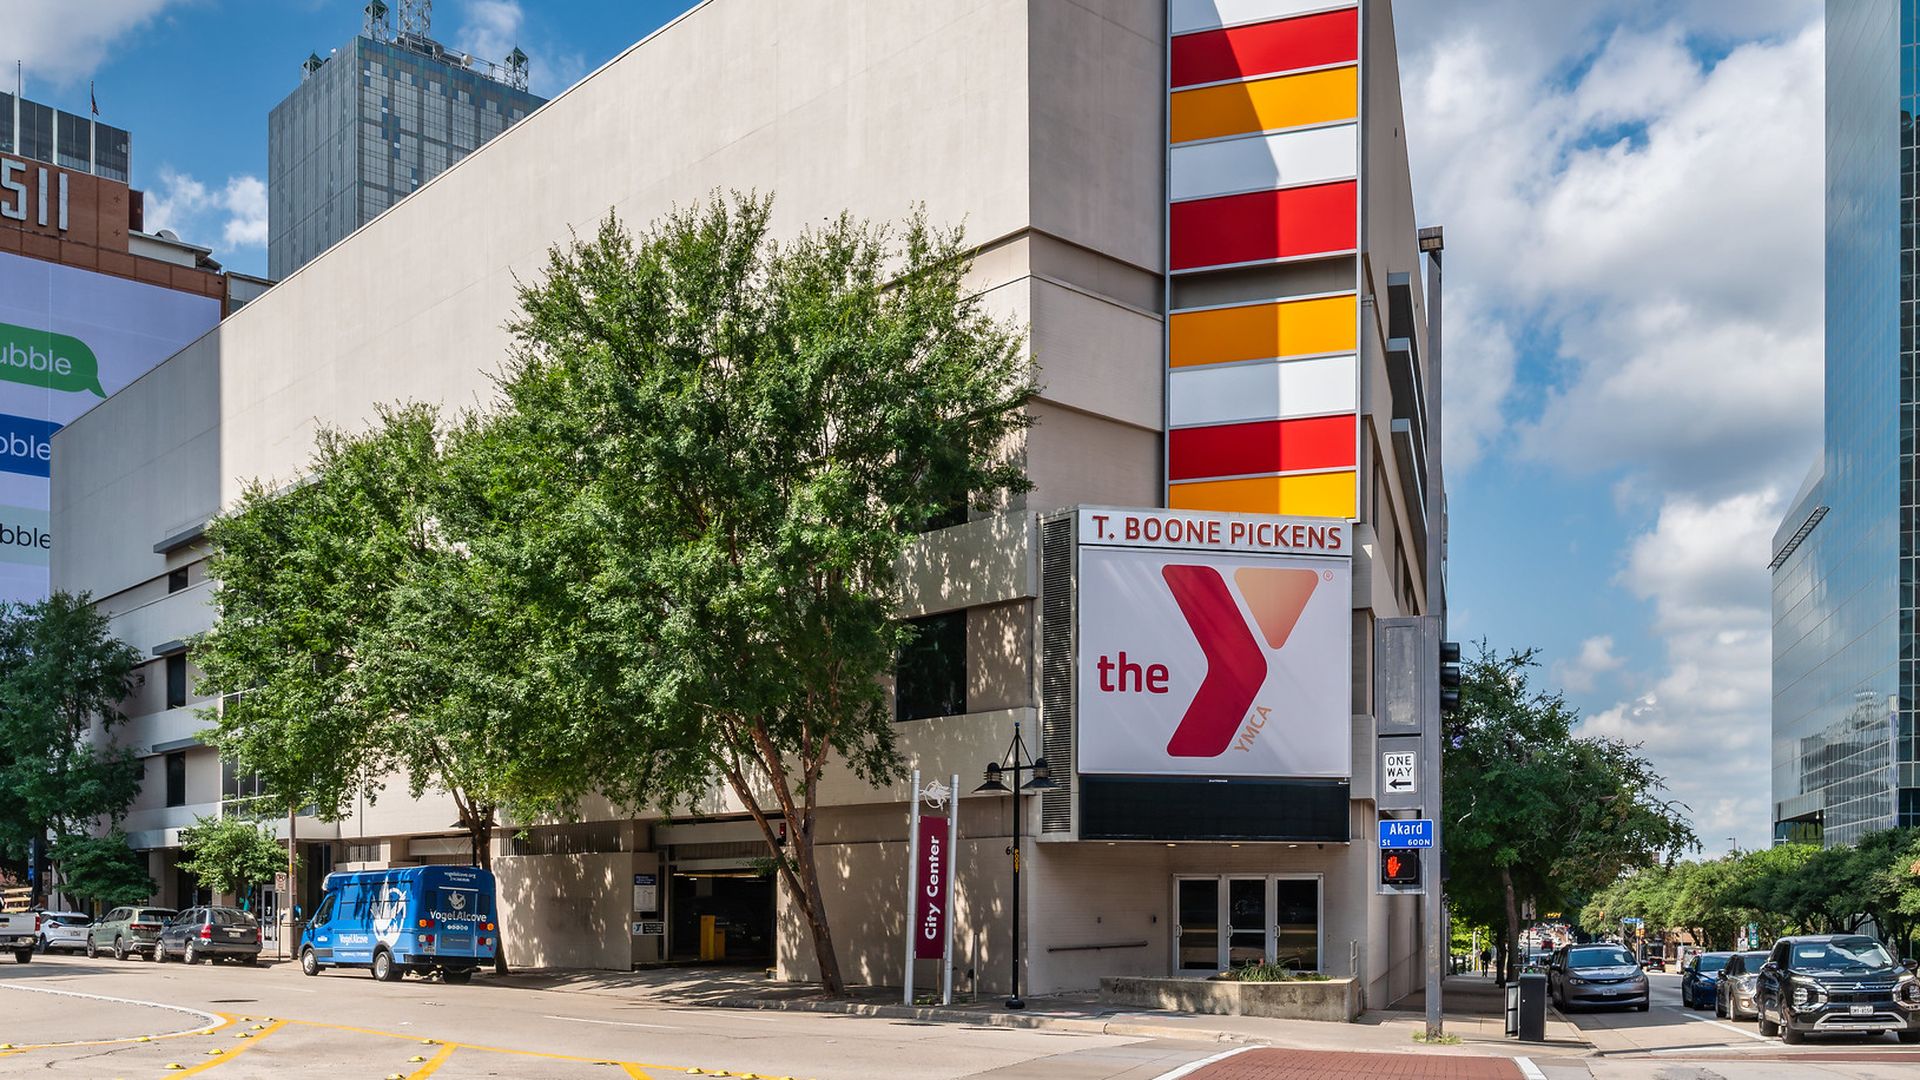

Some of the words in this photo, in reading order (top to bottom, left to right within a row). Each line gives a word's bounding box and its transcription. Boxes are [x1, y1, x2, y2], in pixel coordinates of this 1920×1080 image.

[1092, 515, 1115, 540] T.
[1125, 517, 1221, 544] BOONE
[1231, 522, 1342, 550] PICKENS
[1097, 651, 1169, 694] the
[1234, 705, 1273, 753] YMCA
[1387, 767, 1413, 778] WAY
[1388, 756, 1412, 766] ONE
[1389, 822, 1423, 836] Akard
[926, 835, 941, 898] Center
[924, 903, 941, 940] City
